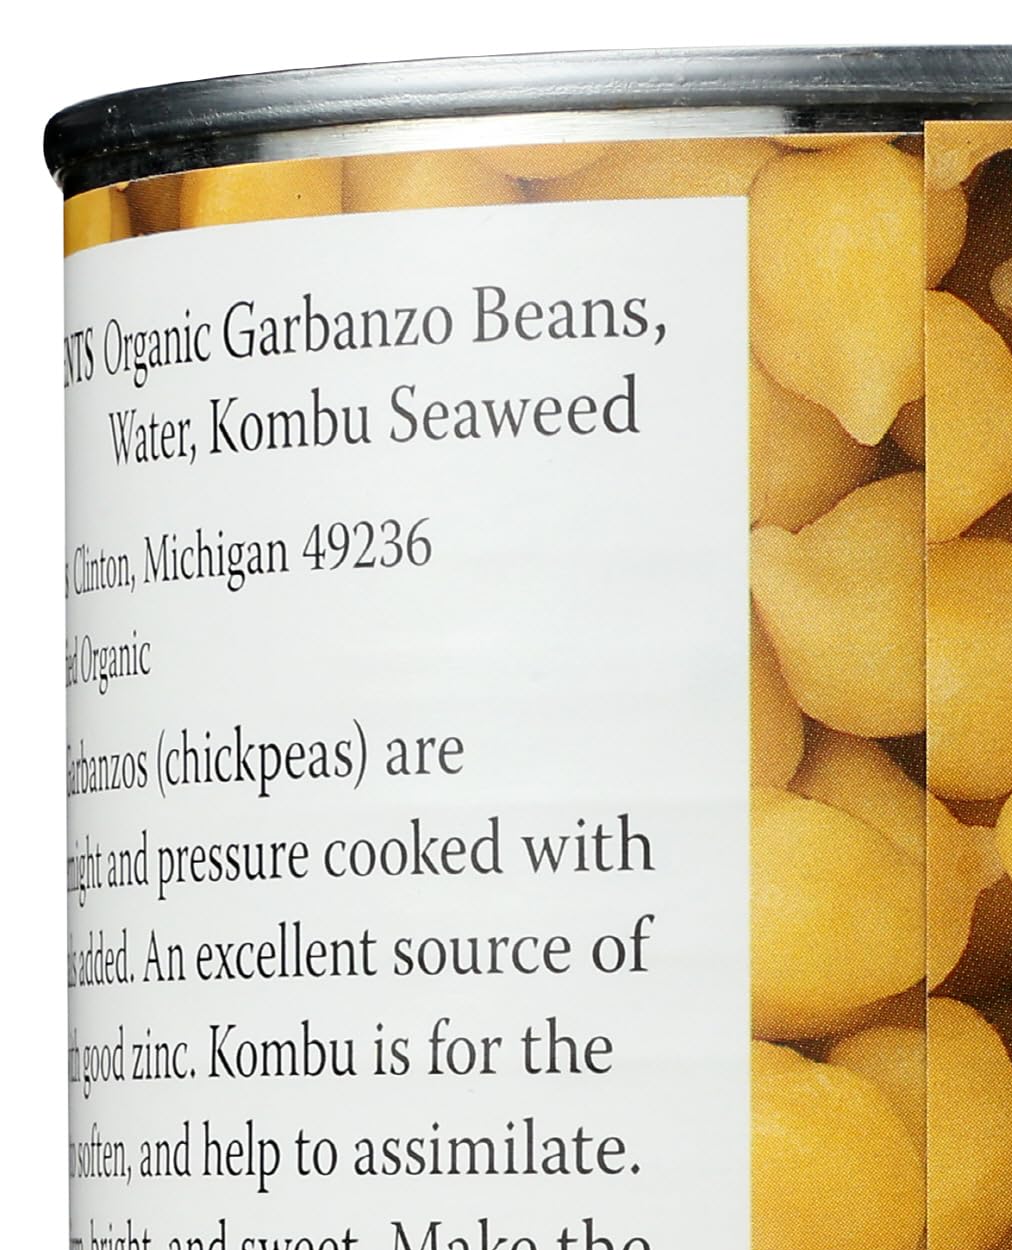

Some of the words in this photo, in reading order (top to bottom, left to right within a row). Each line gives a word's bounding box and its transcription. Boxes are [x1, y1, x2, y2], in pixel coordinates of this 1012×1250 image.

[103, 308, 212, 389] Organic
[222, 292, 453, 359] Garbanzo
[471, 285, 666, 346] Beans,
[108, 408, 197, 466] Water,
[209, 386, 372, 455] Kombu
[389, 372, 641, 444] Seaweed
[73, 542, 136, 597] Clinton,
[143, 527, 290, 593] Michigan
[301, 517, 432, 571] 49236
[80, 629, 151, 696] Organic
[156, 718, 368, 799] (chickpeas)
[385, 736, 465, 776] are
[107, 828, 150, 888] and
[157, 841, 310, 902] pressure
[323, 815, 504, 878] cooked
[520, 812, 656, 874] with
[79, 926, 136, 988] added.
[142, 929, 187, 983] An
[196, 919, 378, 982] excellent
[393, 935, 572, 977] source
[591, 913, 656, 974] of
[82, 1024, 126, 1101] good
[131, 1027, 196, 1081] zinc.
[207, 1018, 358, 1079] Kombu
[373, 1022, 411, 1076] is
[427, 1016, 503, 1076] for
[520, 1015, 613, 1075] the
[78, 1120, 133, 1187] soften,
[139, 1119, 192, 1178] and
[201, 1118, 281, 1194] help
[294, 1128, 338, 1177] to
[353, 1116, 641, 1176] assimilate.
